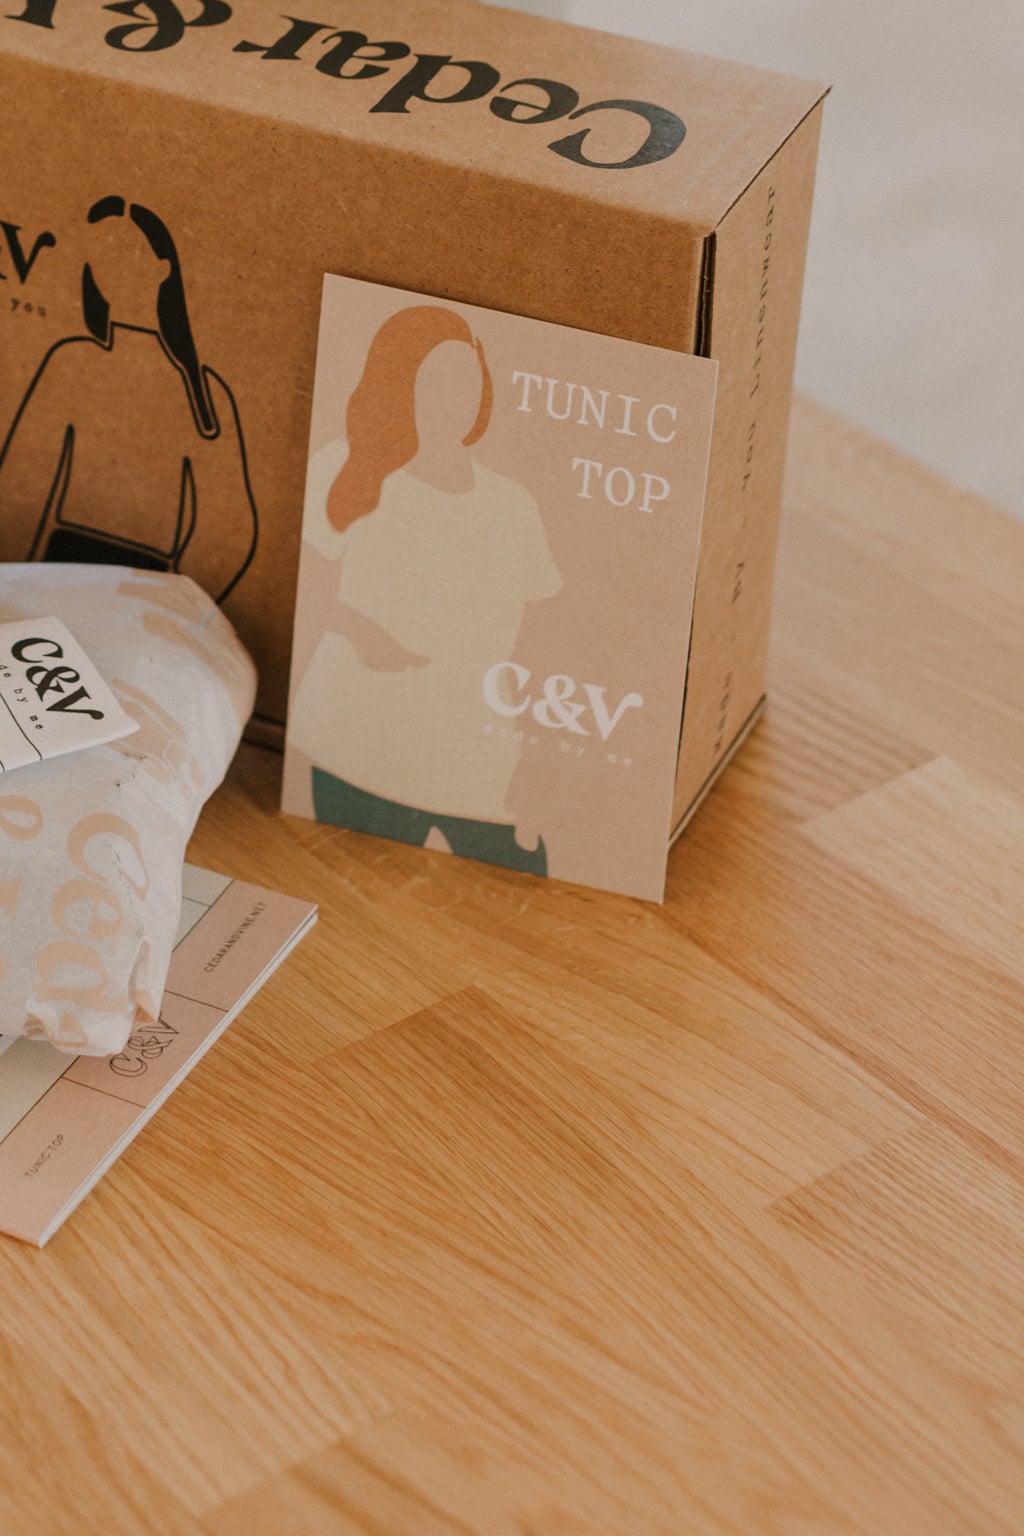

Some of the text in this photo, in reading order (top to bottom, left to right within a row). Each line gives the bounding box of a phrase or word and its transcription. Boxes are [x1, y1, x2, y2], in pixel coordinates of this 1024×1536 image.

[232, 14, 687, 170] Cedar
[11, 298, 47, 318] you
[749, 185, 775, 398] Linenwear
[512, 371, 678, 445] TUNIC
[572, 457, 670, 513] TOP
[11, 637, 105, 720] C&V
[14, 687, 29, 703] by
[29, 715, 43, 730] me
[482, 661, 644, 741] C&V
[560, 740, 586, 757] by
[110, 1011, 179, 1077] C&V
[24, 1134, 64, 1179] TUNIC TOP
